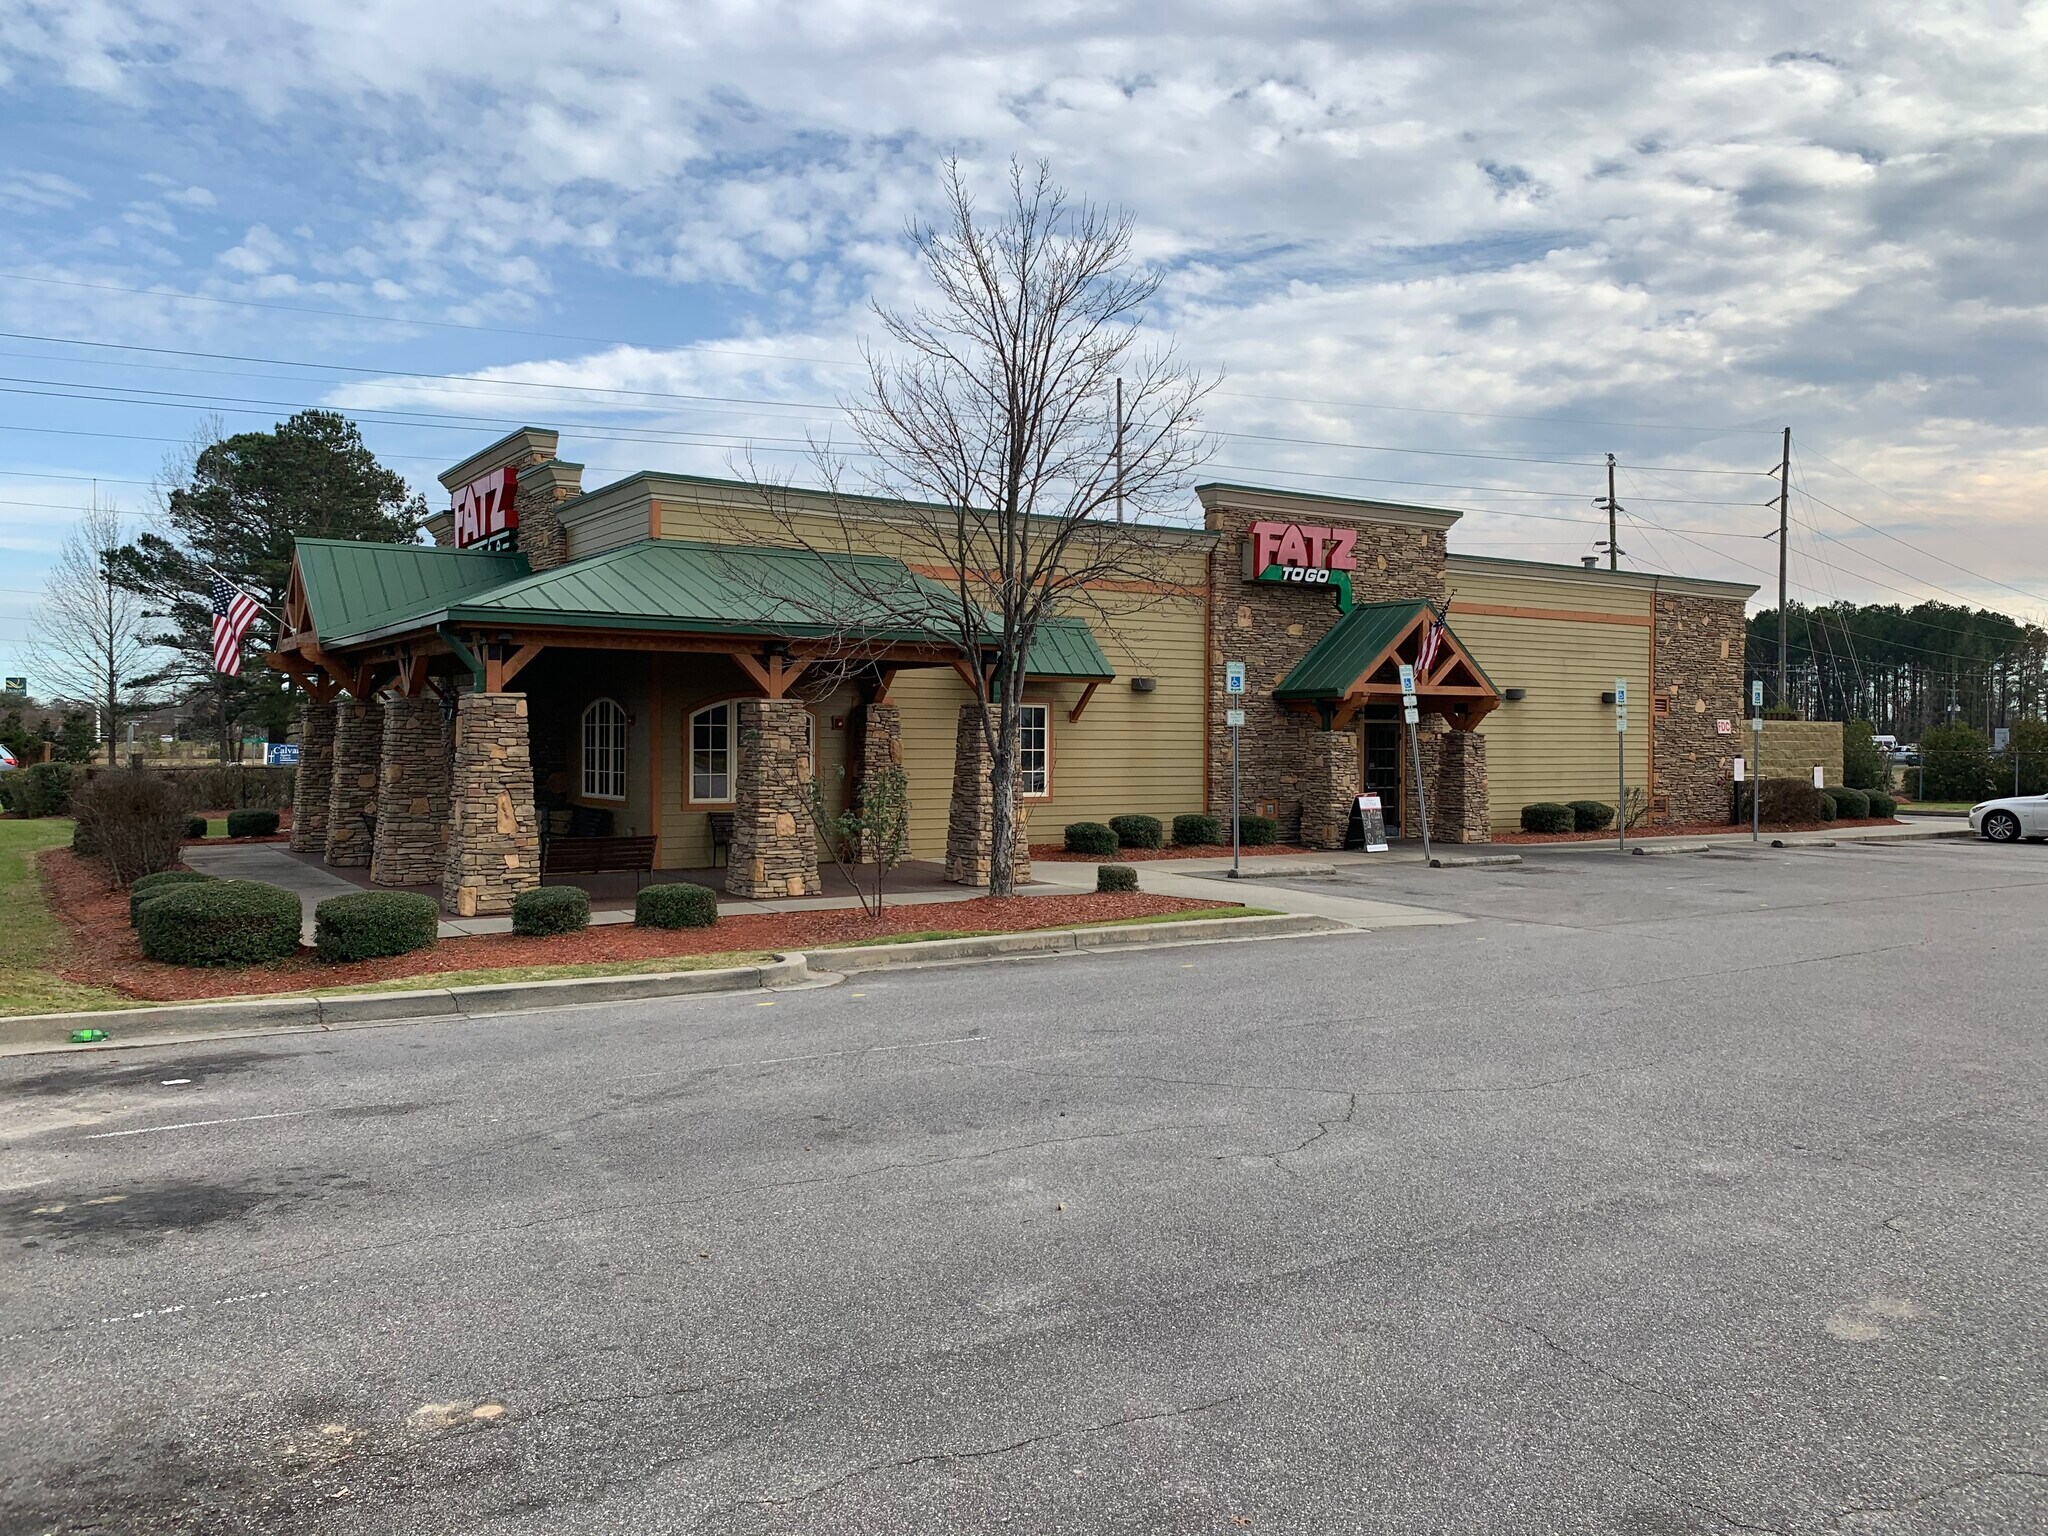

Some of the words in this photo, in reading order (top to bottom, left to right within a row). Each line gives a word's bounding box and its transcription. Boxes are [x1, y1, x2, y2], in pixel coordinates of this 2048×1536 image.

[452, 468, 506, 549] FATZ
[1252, 521, 1357, 578] FATZ
[1282, 566, 1305, 581] TO
[1304, 568, 1330, 583] GO
[1717, 721, 1731, 732] FDC
